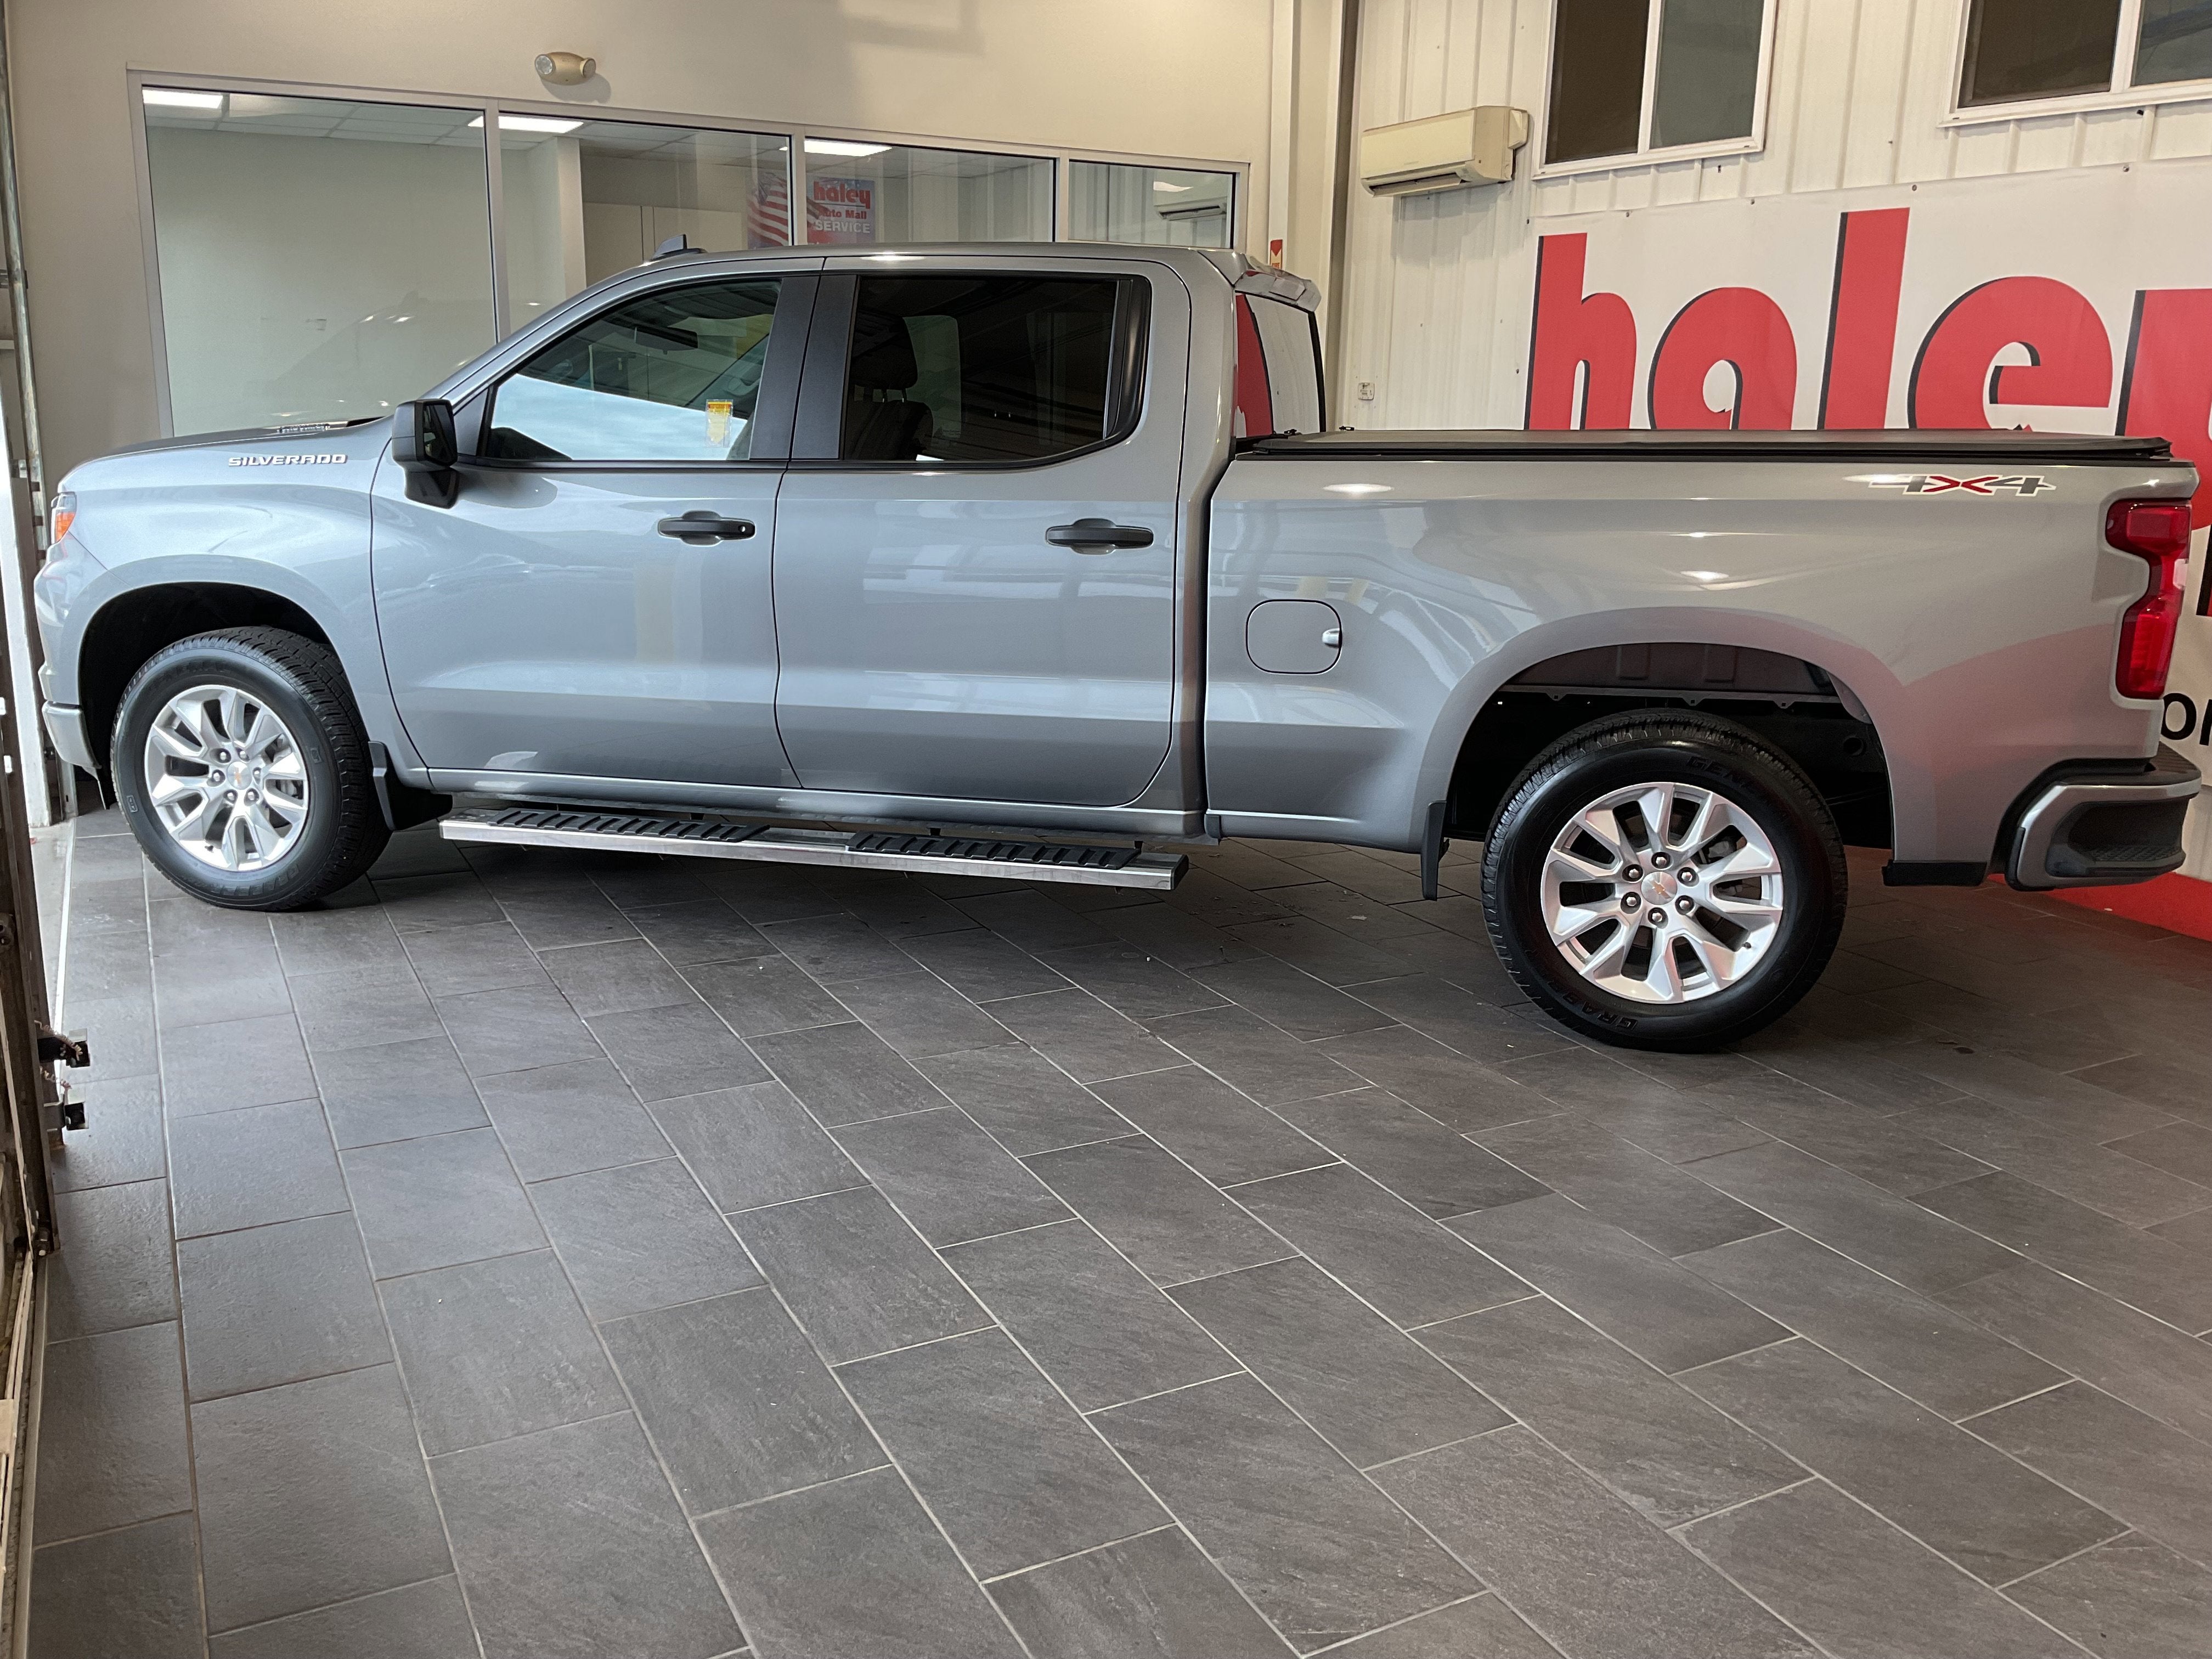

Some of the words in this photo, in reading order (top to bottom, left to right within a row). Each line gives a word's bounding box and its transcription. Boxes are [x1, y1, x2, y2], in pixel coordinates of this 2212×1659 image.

[813, 180, 871, 210] haley
[845, 210, 867, 219] Mall
[815, 219, 870, 233] SERVICE
[228, 454, 348, 467] SILVERADO
